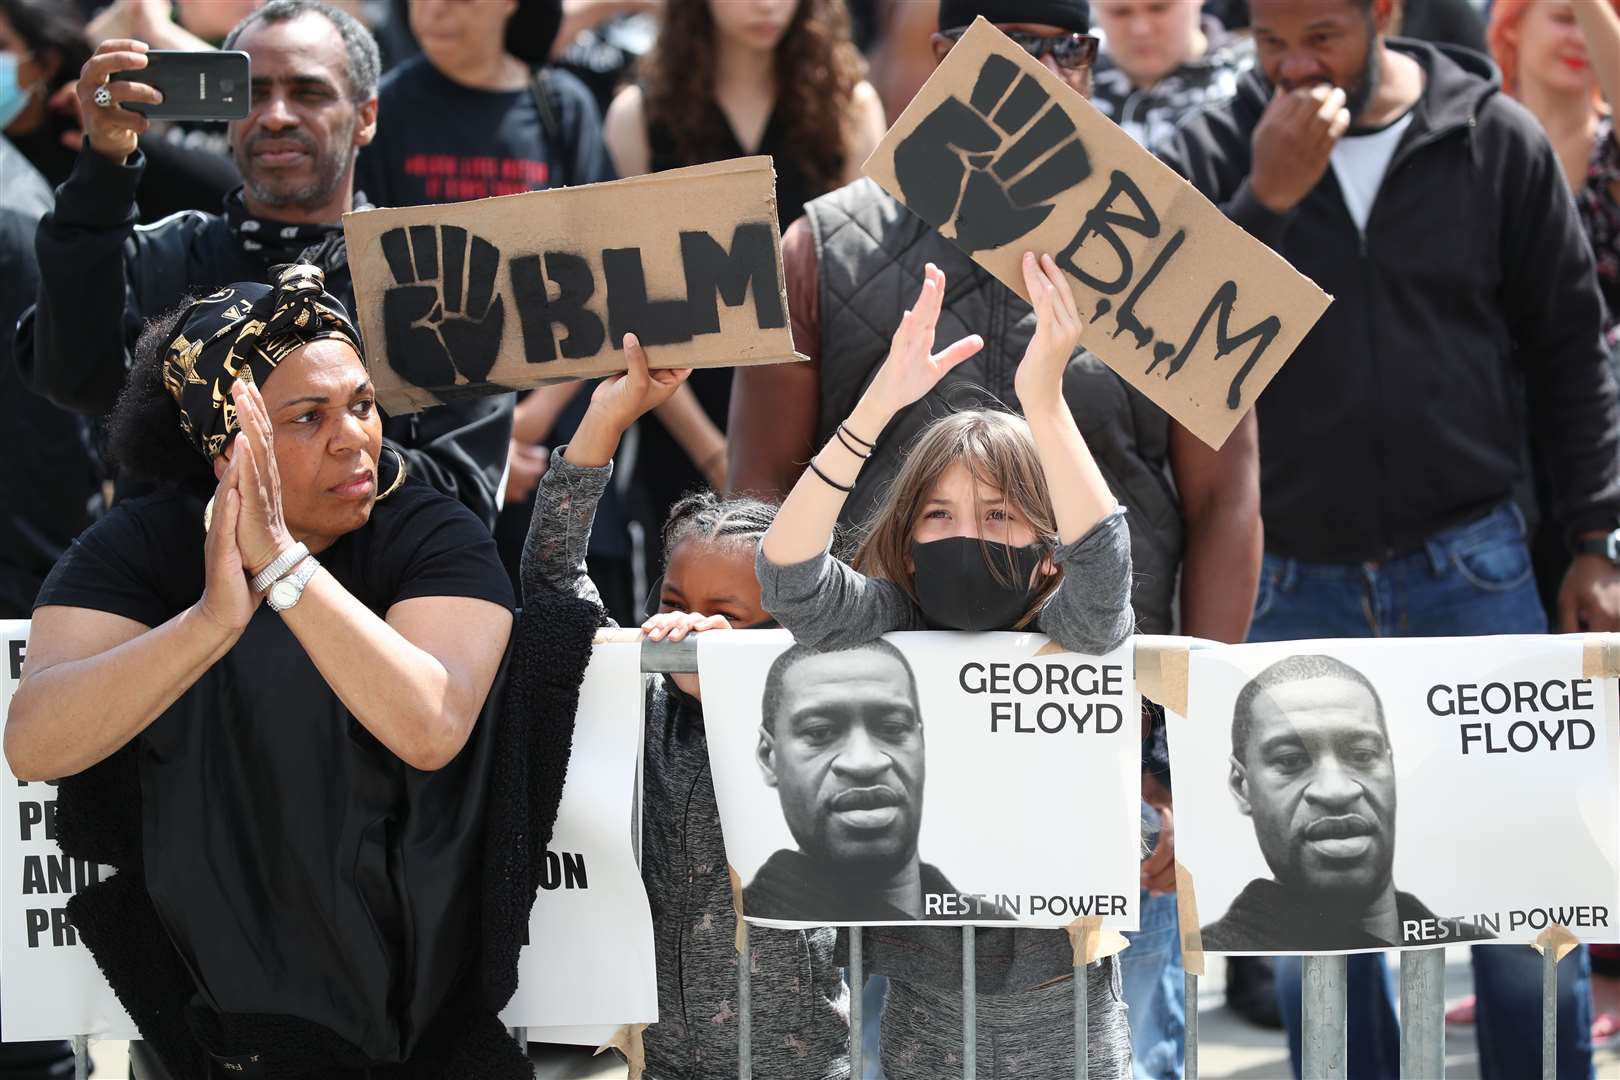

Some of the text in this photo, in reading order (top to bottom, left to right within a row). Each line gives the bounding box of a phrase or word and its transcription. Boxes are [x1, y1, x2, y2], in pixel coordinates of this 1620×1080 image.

[509, 223, 786, 364] BLM
[958, 662, 1123, 696] GEORGE
[1426, 679, 1594, 716] GEORGE
[990, 702, 1123, 734] FLOYD
[1460, 719, 1596, 755] FLOYD
[925, 893, 1127, 916] REST IN POWER
[1403, 906, 1609, 941] REST IN POWER
